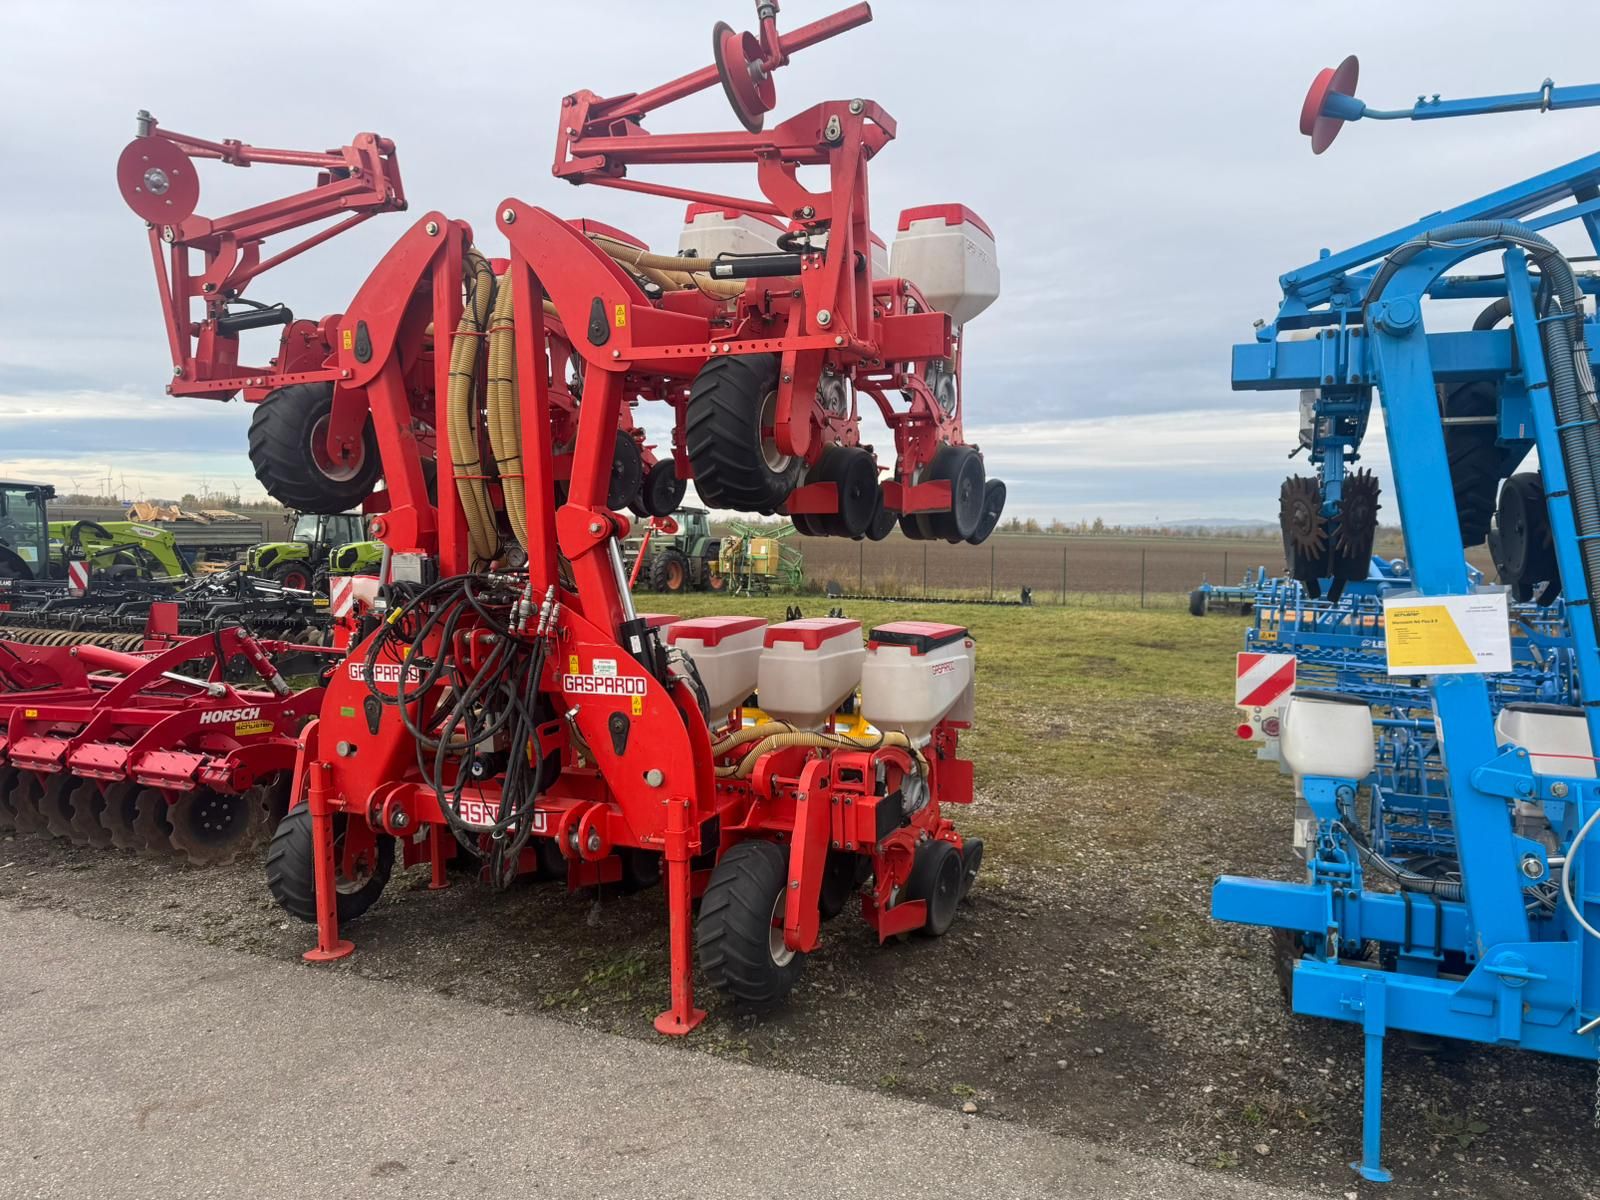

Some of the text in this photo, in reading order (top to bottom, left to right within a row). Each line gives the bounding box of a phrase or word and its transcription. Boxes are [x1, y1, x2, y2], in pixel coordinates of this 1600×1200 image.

[350, 664, 418, 682] GAPARO
[564, 675, 645, 694] GASPARDO
[199, 707, 261, 724] HORSCH
